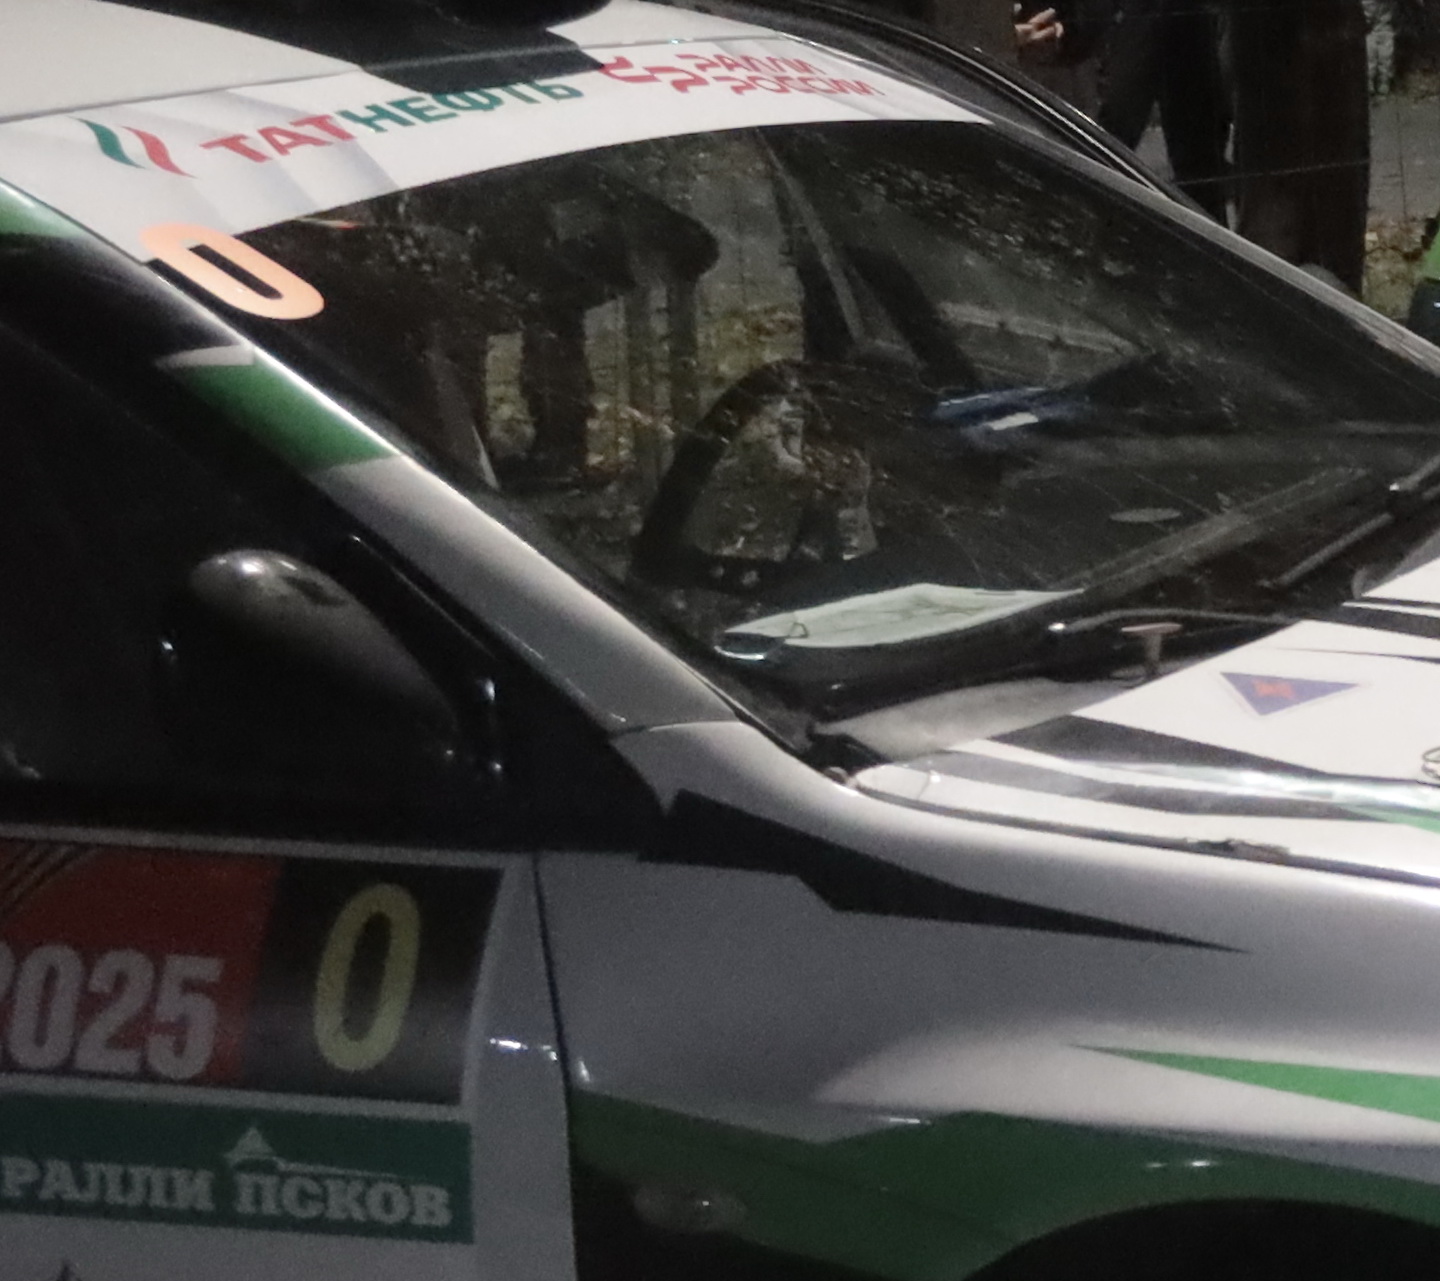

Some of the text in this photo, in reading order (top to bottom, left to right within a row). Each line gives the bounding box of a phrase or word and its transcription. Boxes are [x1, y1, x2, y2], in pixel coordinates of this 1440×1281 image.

[202, 77, 584, 165] ТАТНЕФТЬ
[142, 223, 325, 321] 0
[0, 939, 223, 1080] 025
[312, 882, 421, 1072] 0
[1, 1156, 453, 1228] РАЛЛИ ПСКОВ
